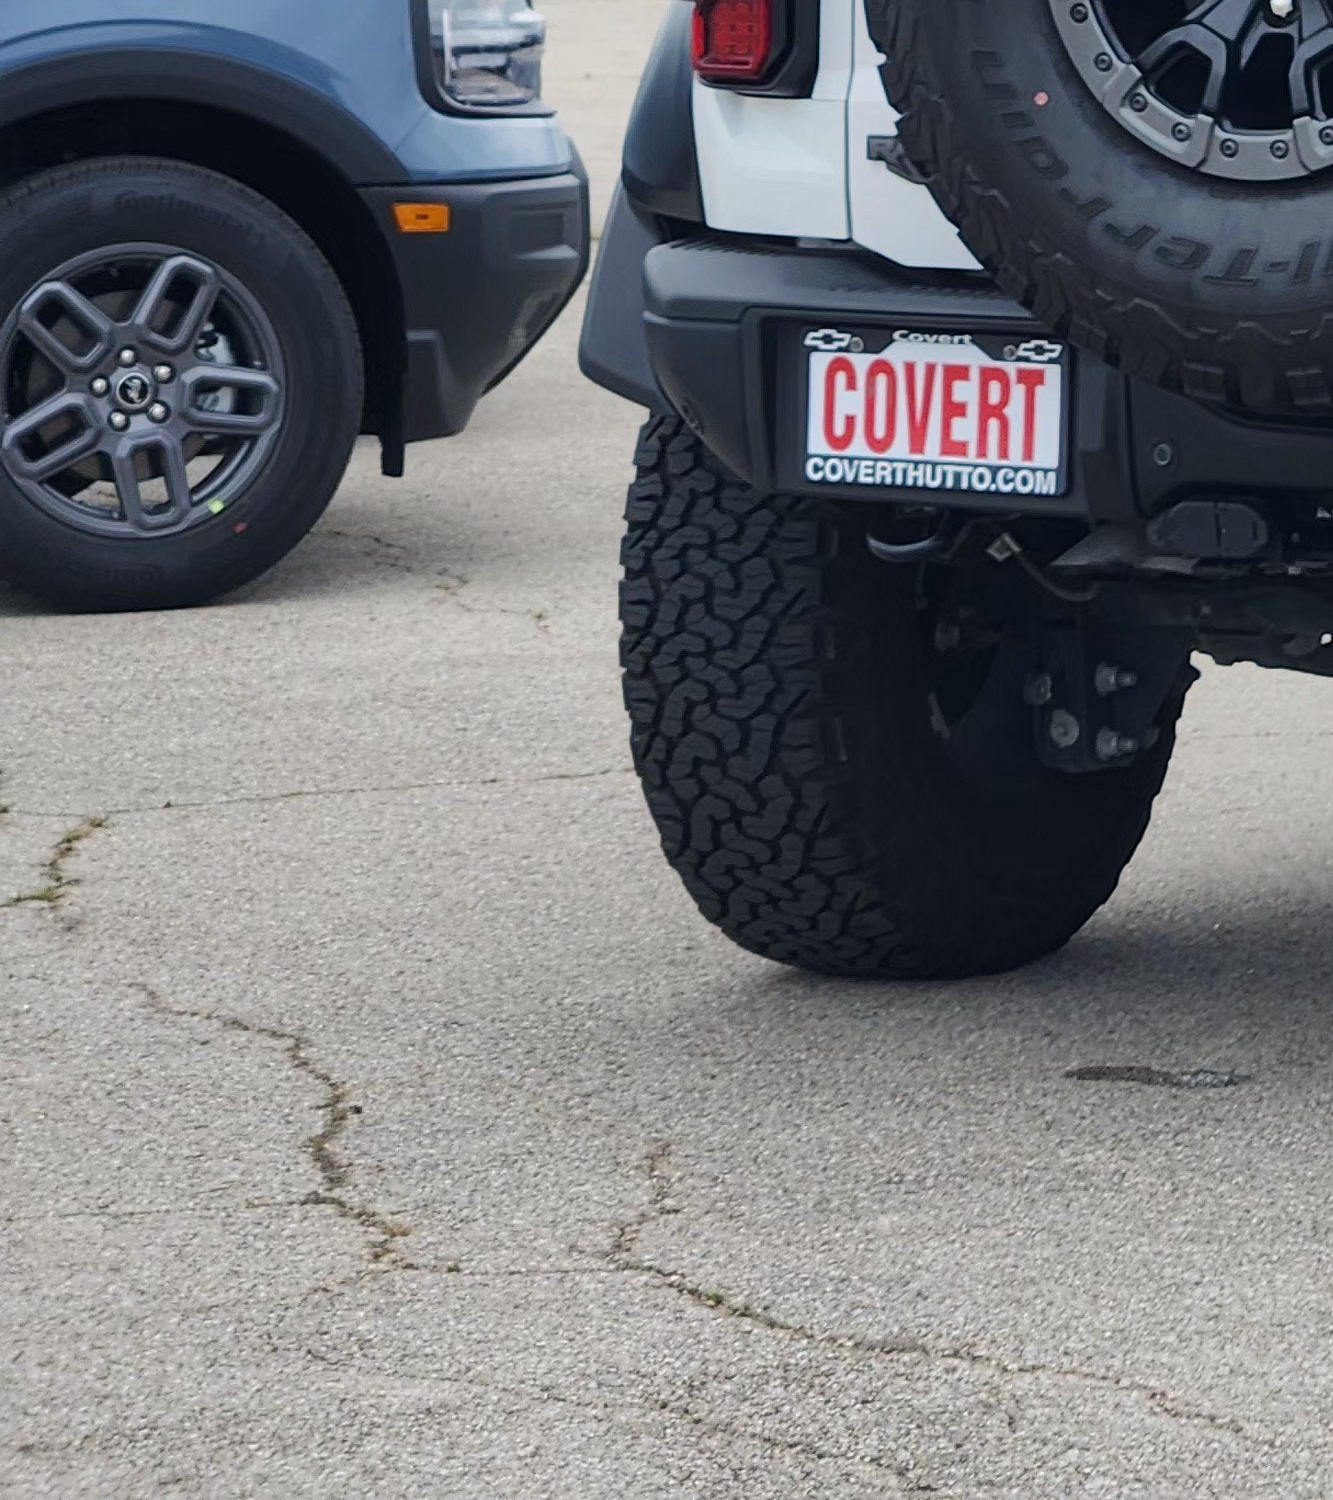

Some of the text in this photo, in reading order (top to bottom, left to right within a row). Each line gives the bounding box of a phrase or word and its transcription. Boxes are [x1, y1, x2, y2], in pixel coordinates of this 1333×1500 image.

[892, 330, 972, 345] Covert
[823, 356, 1045, 461] COVERT
[806, 457, 1056, 494] COVERTHUTTO.COM
